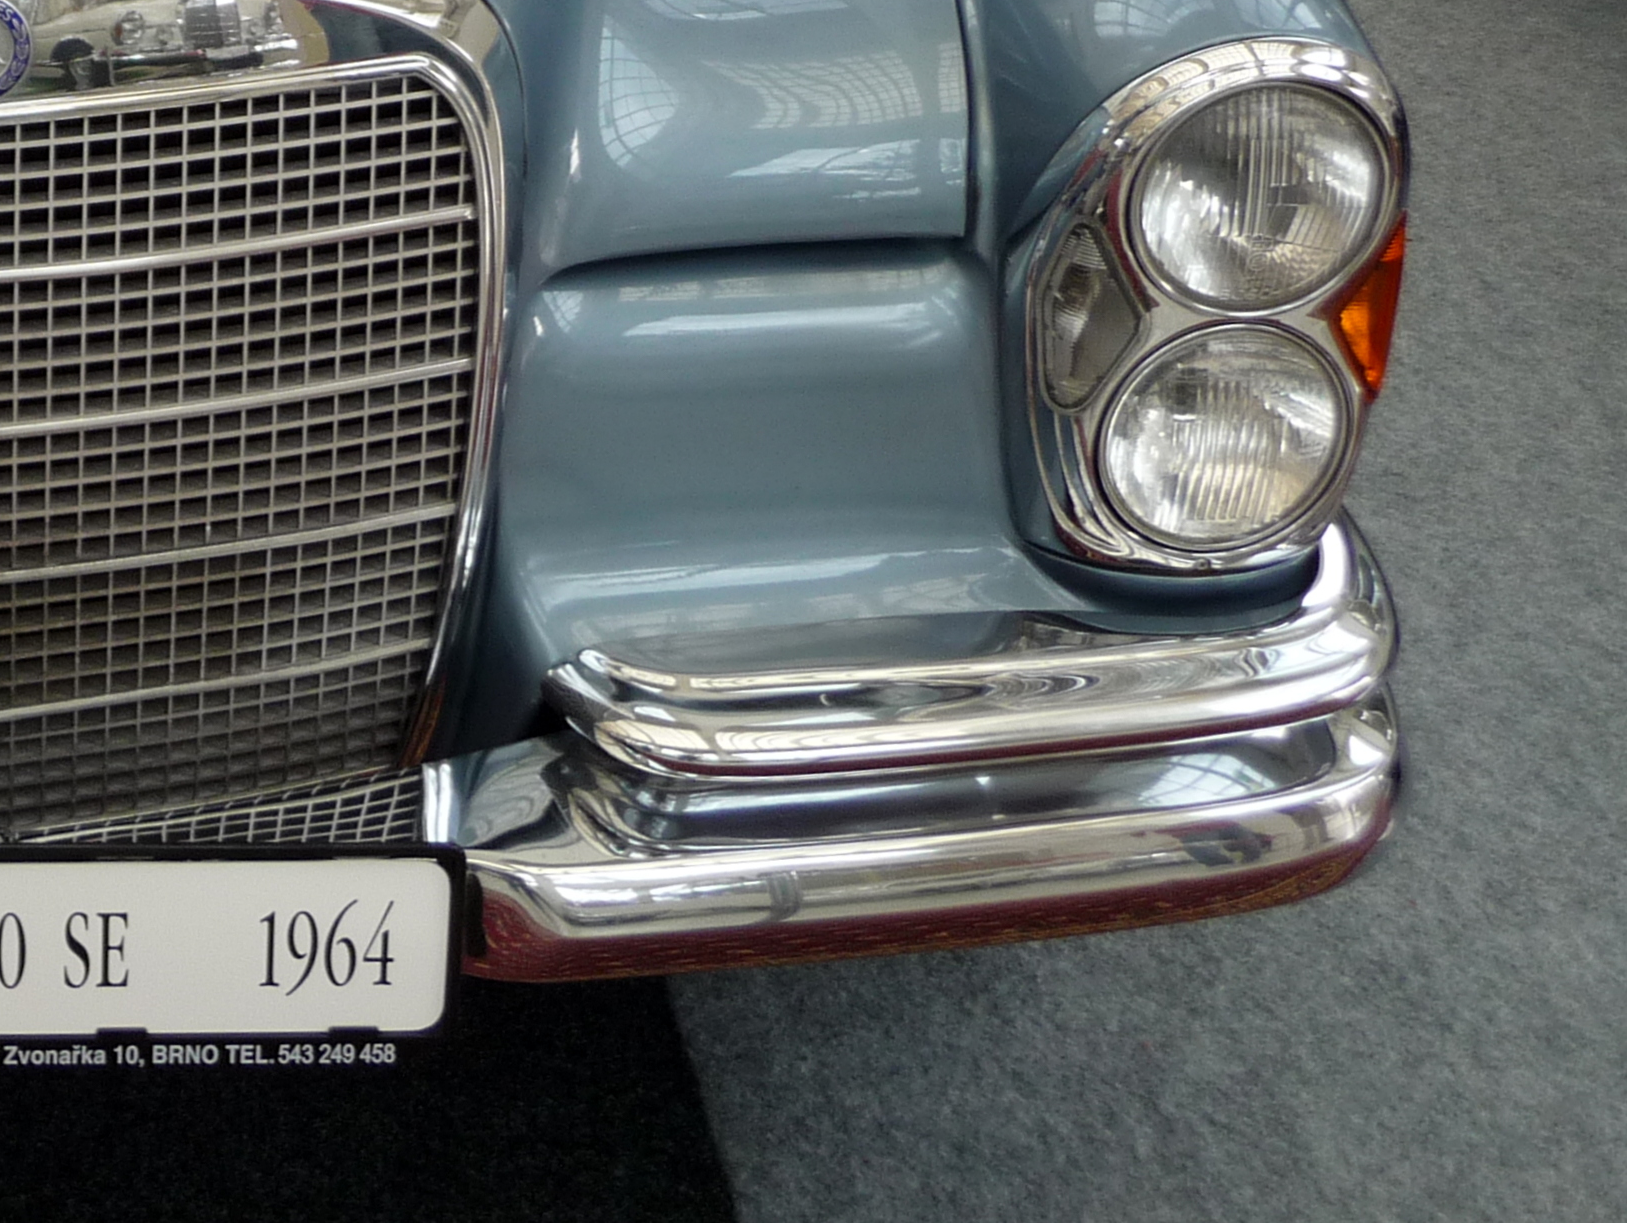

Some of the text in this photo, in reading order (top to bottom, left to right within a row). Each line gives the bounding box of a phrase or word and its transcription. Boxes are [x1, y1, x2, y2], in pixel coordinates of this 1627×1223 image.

[64, 911, 129, 989] SE
[258, 898, 395, 997] 1964
[3, 1044, 107, 1065] Zvonařka
[113, 1044, 145, 1068] 10,
[152, 1044, 219, 1065] BRNO
[225, 1044, 275, 1065] TEL.
[277, 1043, 315, 1065] 543
[318, 1043, 356, 1064] 249
[358, 1042, 397, 1064] 458
